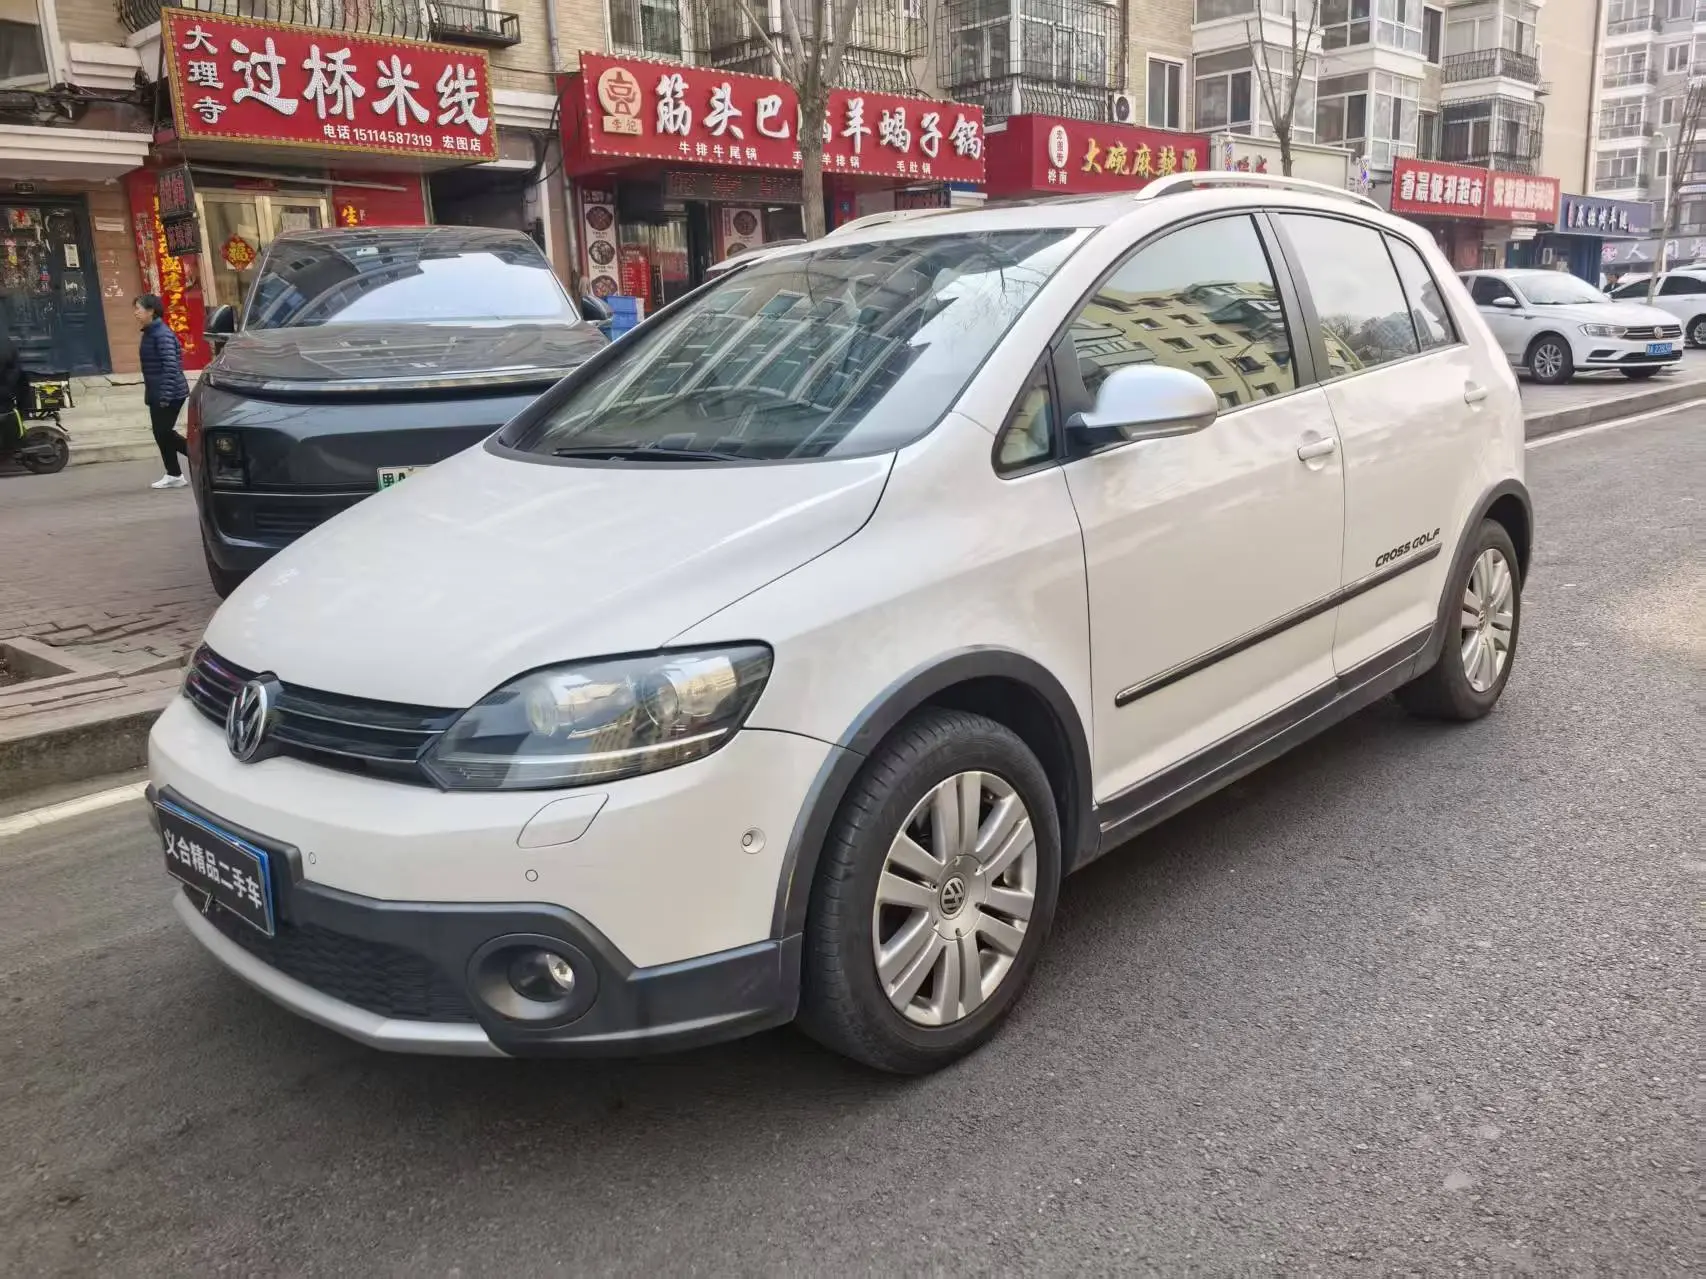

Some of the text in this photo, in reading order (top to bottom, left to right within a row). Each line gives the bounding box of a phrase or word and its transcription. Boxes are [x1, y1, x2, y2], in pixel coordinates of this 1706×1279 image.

[183, 25, 228, 124] 大理寺
[230, 37, 489, 135] 过桥米线
[323, 123, 481, 152] 电话 15114587319 宏图店
[679, 141, 758, 161] 牛排牛尾锅
[792, 151, 860, 168] 手羊排锅
[896, 160, 931, 174] 毛肚锅
[1375, 527, 1441, 568] CROSS GOLF
[163, 828, 263, 909] 义合精品二手车
